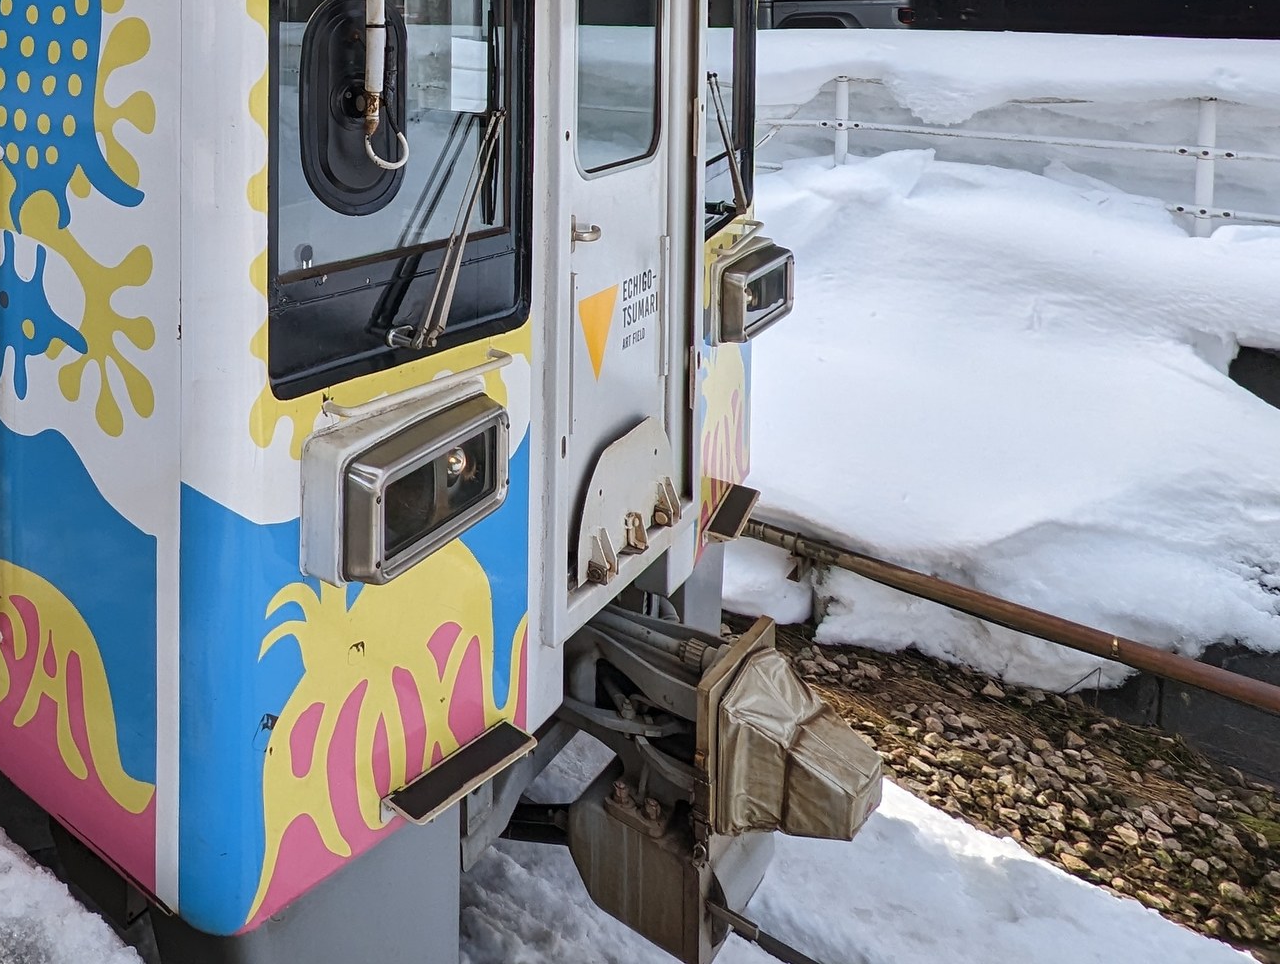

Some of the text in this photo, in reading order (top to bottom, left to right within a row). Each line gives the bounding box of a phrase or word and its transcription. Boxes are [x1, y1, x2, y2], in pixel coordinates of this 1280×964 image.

[622, 269, 657, 302] ECHIGO-
[622, 291, 658, 328] TSUMARI
[622, 327, 646, 350] ART FIELD
